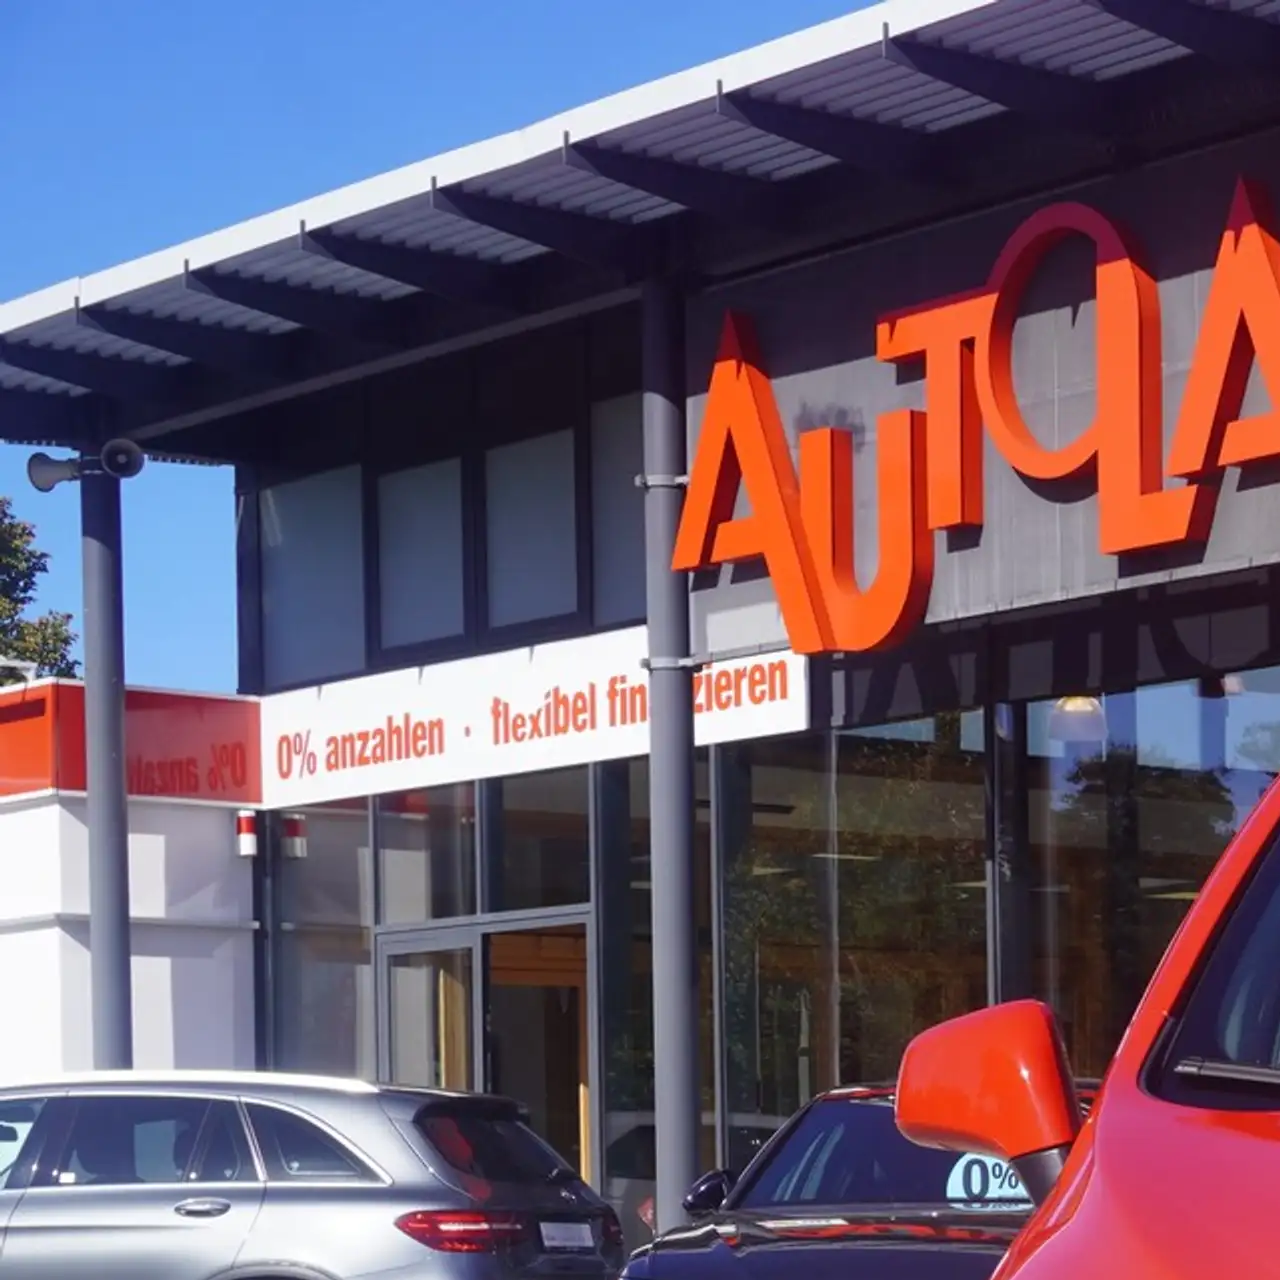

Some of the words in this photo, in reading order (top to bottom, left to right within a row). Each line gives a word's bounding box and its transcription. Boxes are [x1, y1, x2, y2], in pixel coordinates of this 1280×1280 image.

[277, 727, 317, 780] 0%
[325, 712, 445, 772] anzahlen
[491, 682, 597, 746] flexibel
[607, 659, 788, 727] finzieren
[962, 1158, 1019, 1200] 0%
